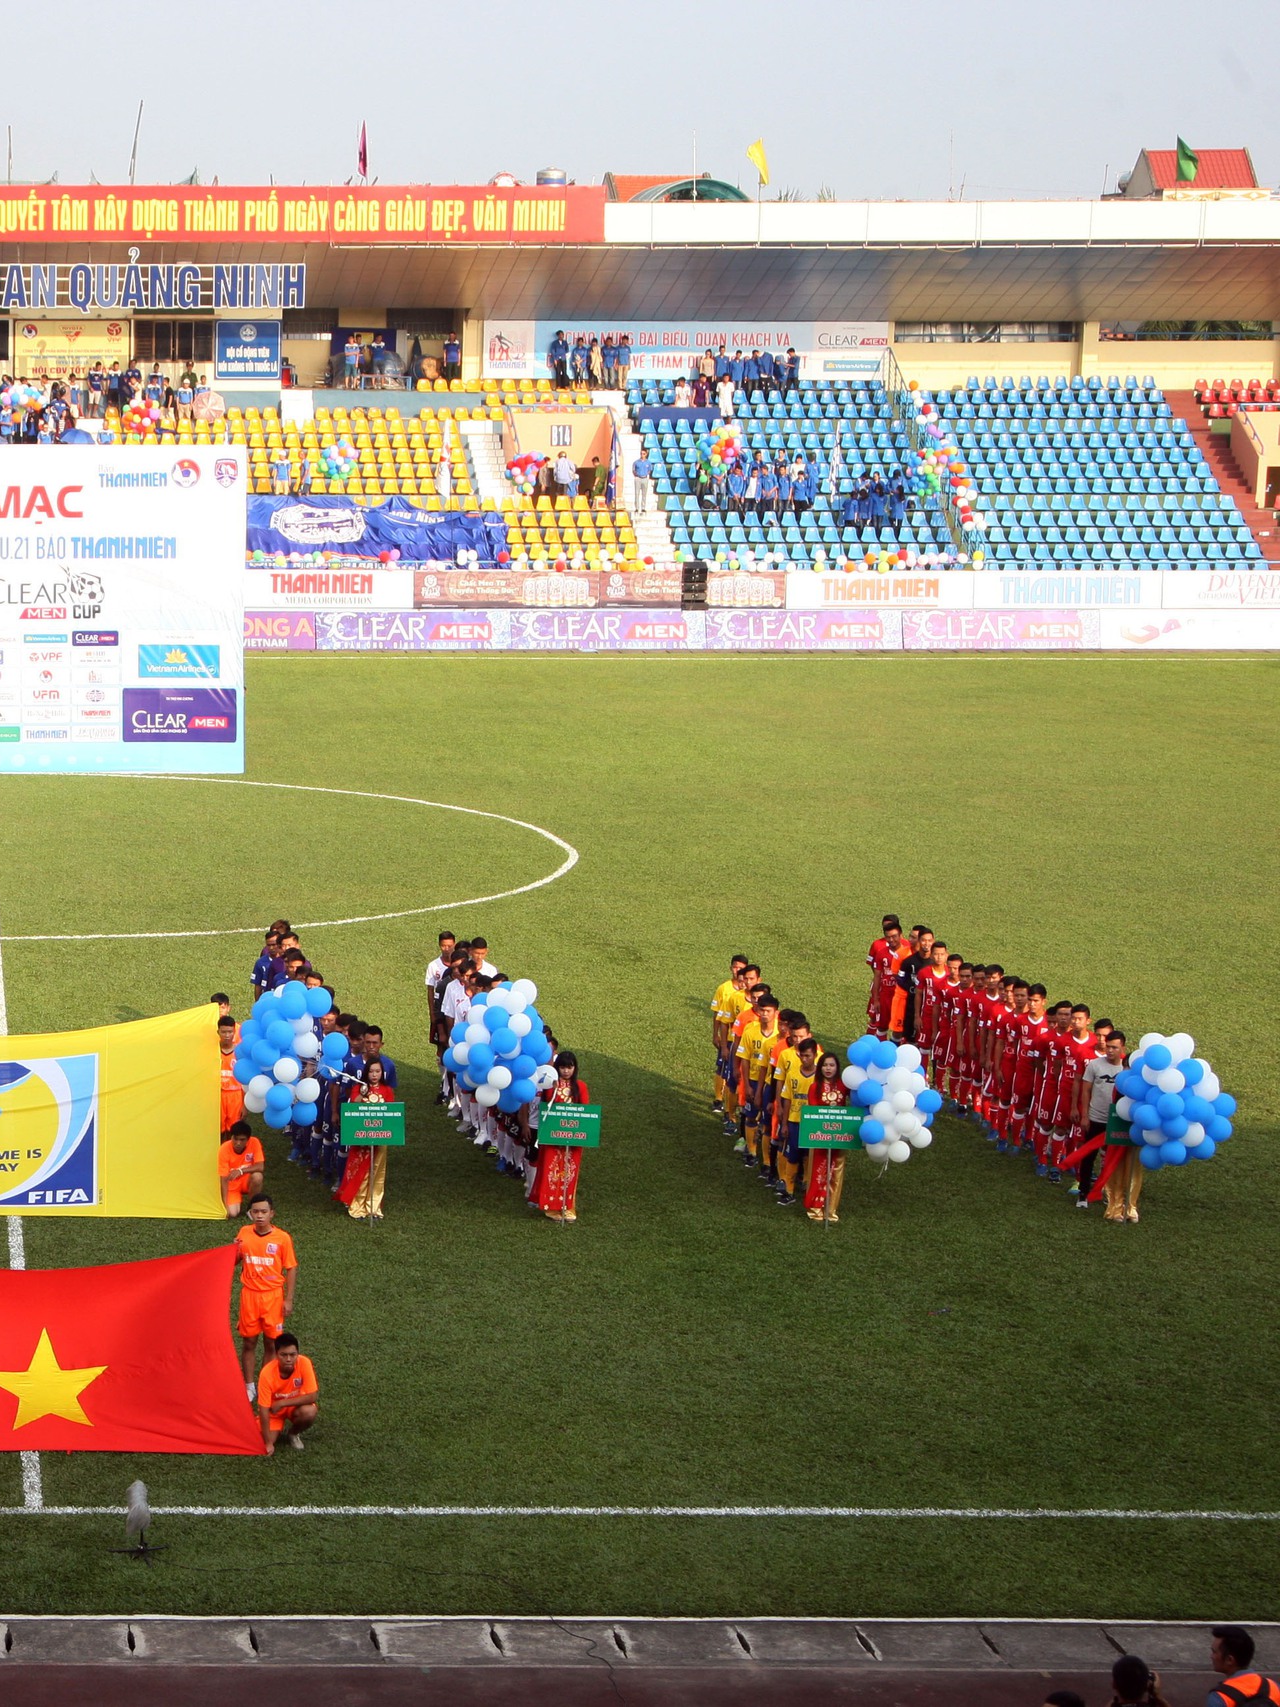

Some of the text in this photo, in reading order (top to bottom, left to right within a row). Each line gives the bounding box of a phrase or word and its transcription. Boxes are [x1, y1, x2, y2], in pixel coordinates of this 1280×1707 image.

[51, 194, 88, 231] TÂM
[94, 194, 127, 231] XÂY
[132, 198, 178, 238] DỰNG
[184, 194, 238, 231] THÀNH
[245, 190, 278, 231] PHỐ
[284, 195, 329, 231] NGÀY
[334, 195, 379, 231] CÀNG
[385, 194, 426, 231] GIÀU
[431, 199, 466, 238] ĐẸP,
[473, 194, 507, 231] VĂN
[513, 200, 566, 231] MINH!
[69, 247, 202, 314] QUẢNG
[212, 263, 306, 308] NINH
[818, 332, 858, 345] CLEAR
[0, 537, 30, 560] U.21
[27, 604, 101, 620] MEN CUP
[294, 617, 314, 636] A
[333, 612, 489, 640] CLEAR MEN
[528, 612, 684, 640] CLEAR MEN
[723, 611, 880, 640] CLEAR MEN
[920, 611, 1079, 640] CLEAR MEN
[41, 652, 63, 660] VPF
[132, 709, 225, 729] CLEAR MEN
[26, 1149, 42, 1159] IS
[28, 1189, 89, 1204] FIFA
